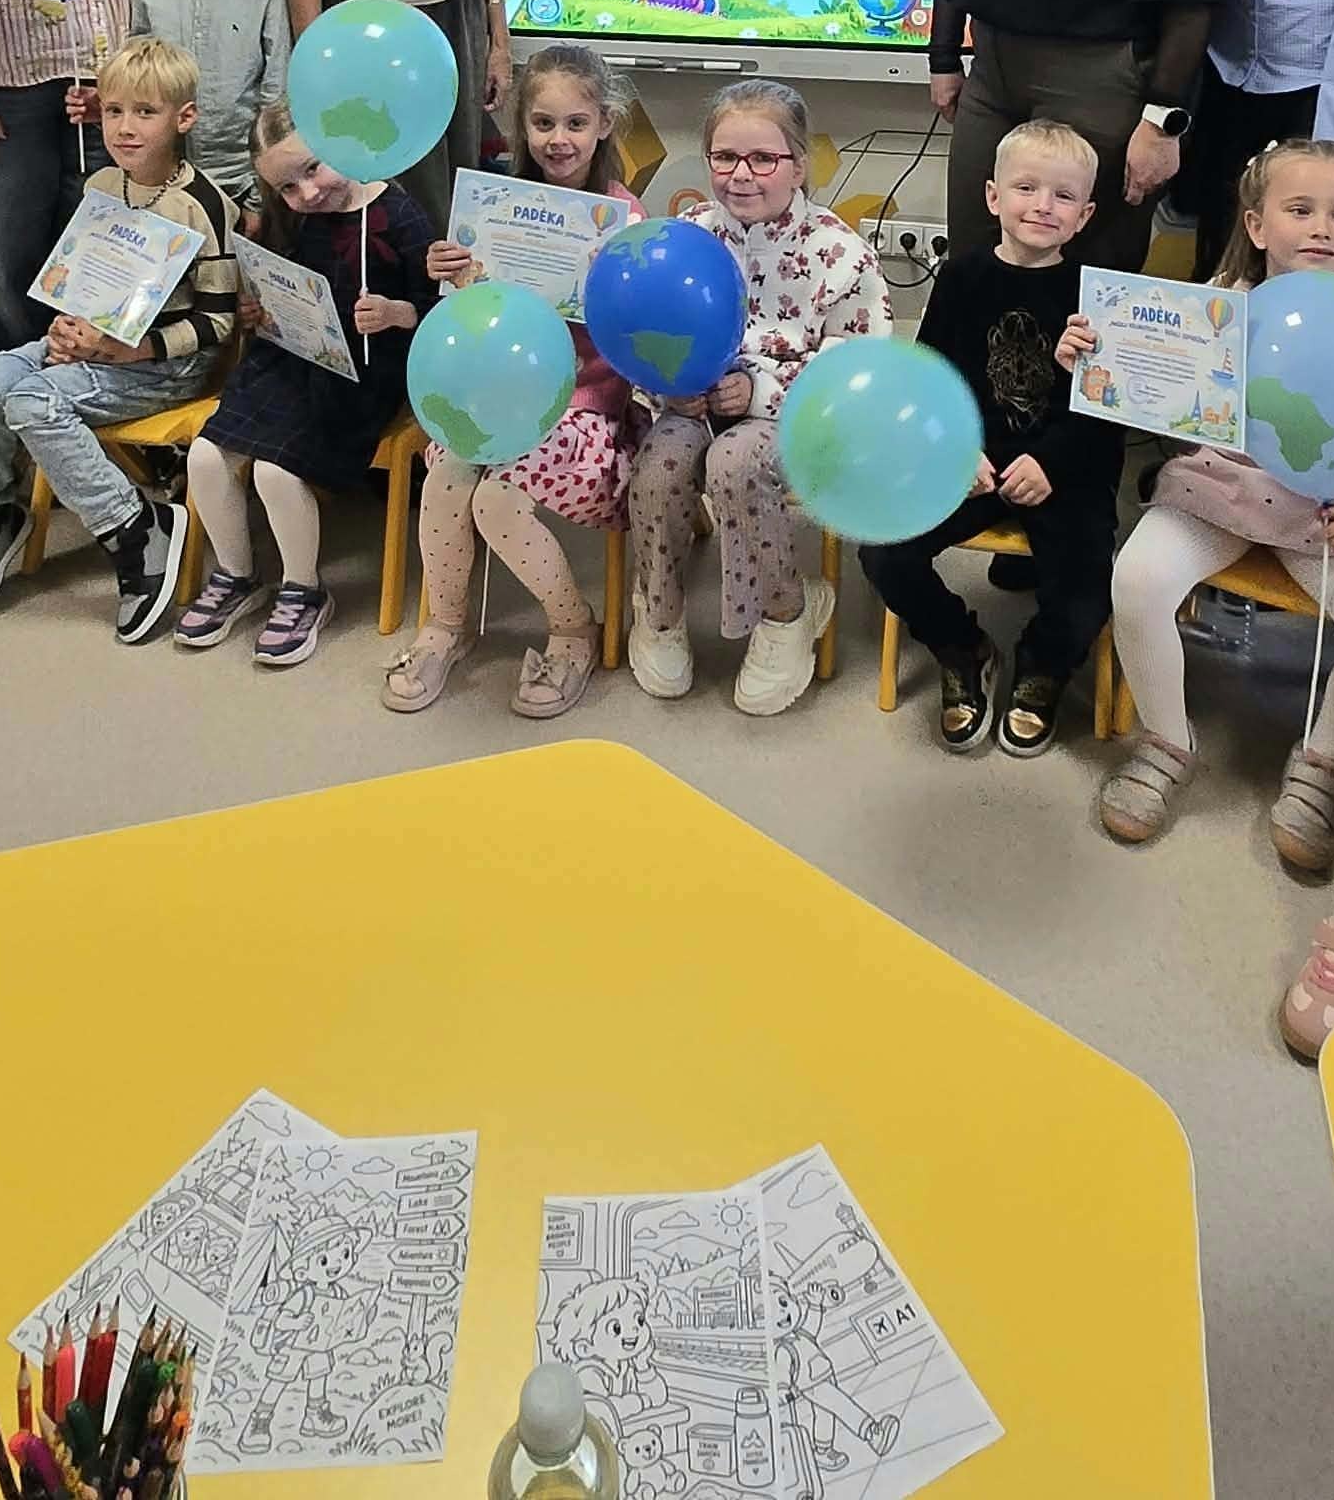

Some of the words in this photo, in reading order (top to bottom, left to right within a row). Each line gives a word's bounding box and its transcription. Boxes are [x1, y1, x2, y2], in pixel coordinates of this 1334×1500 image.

[513, 204, 565, 228] PADĖKA
[108, 223, 147, 248] PADĖKA
[1132, 305, 1181, 329] PADĖKA
[895, 1302, 916, 1325] A1
[378, 1393, 426, 1420] EXPLORE
[387, 1408, 423, 1432] MORE!
